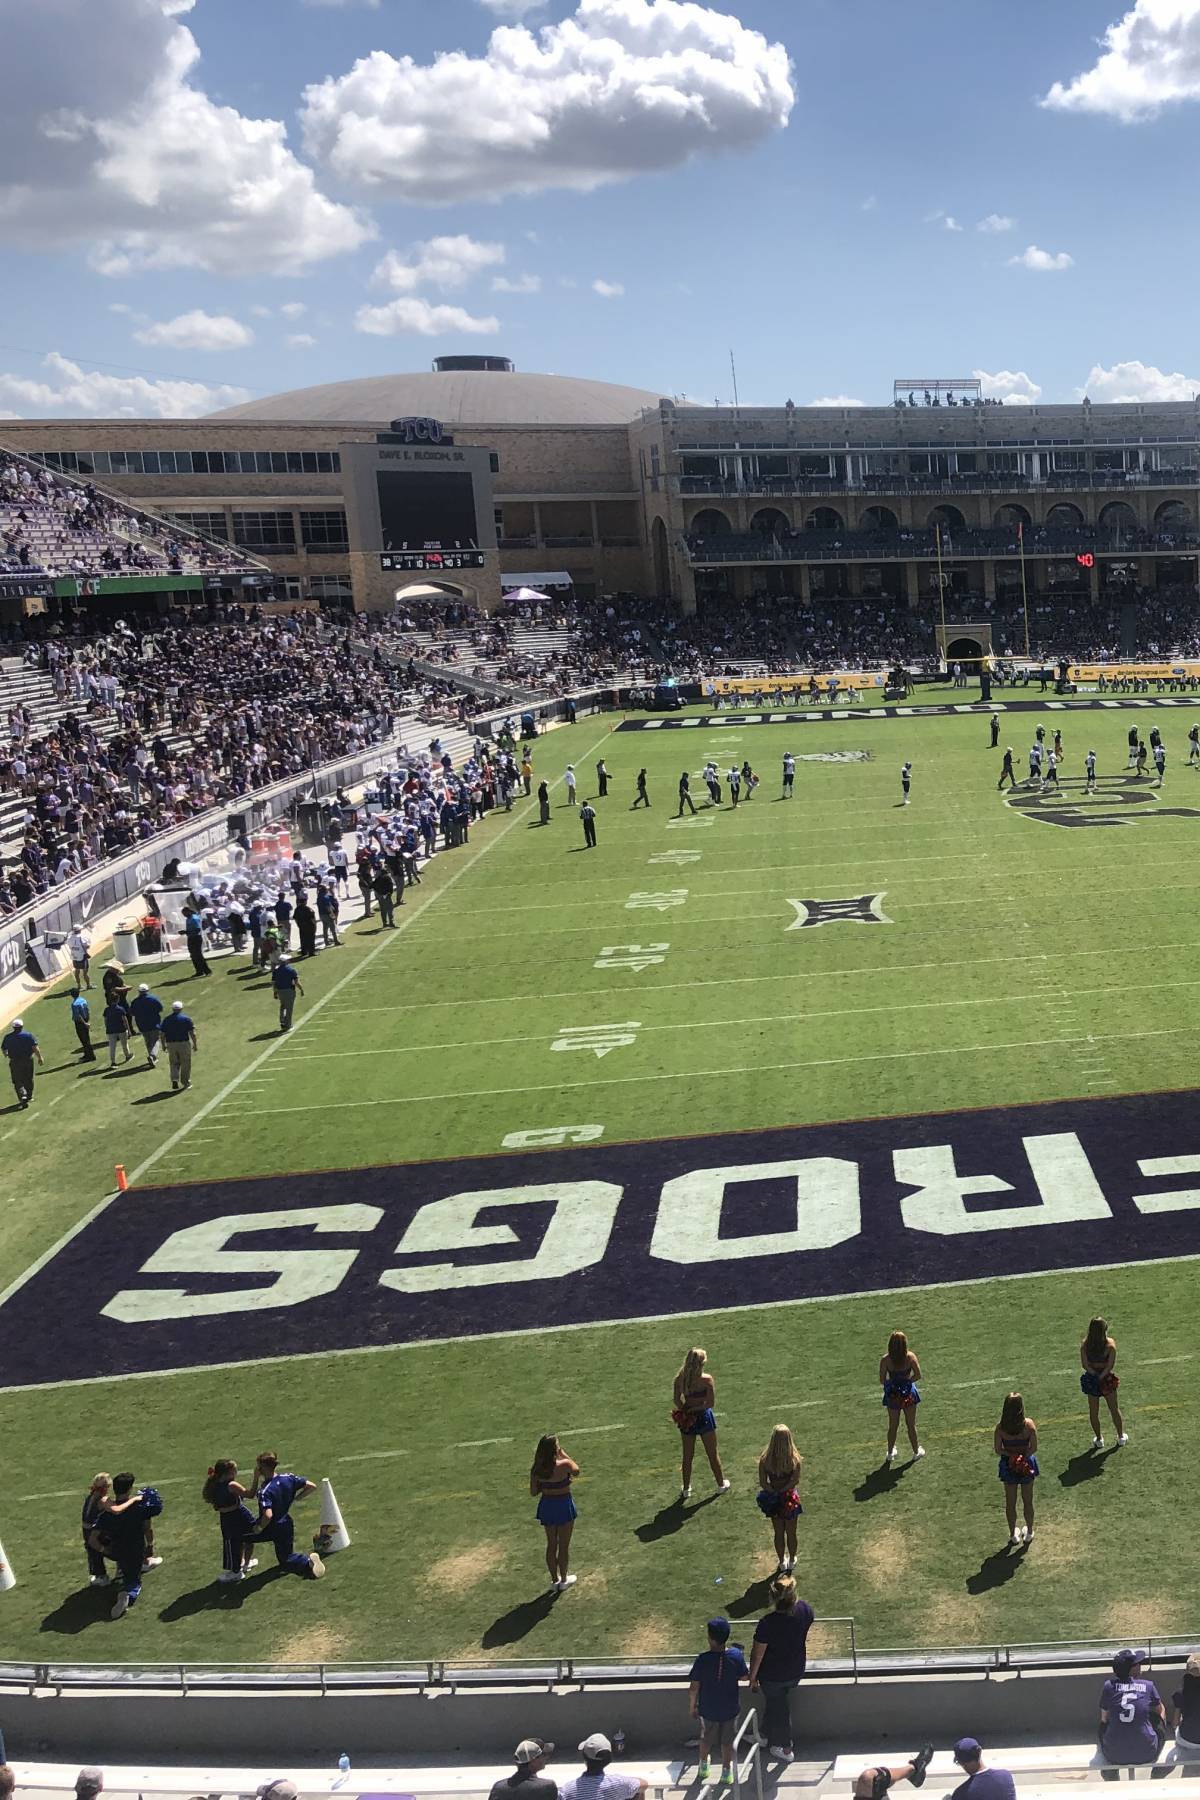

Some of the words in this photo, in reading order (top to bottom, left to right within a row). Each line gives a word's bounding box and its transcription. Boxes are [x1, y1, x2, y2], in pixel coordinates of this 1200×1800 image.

[401, 417, 443, 443] TCU
[382, 558, 391, 567] 38
[1077, 553, 1094, 568] 40
[642, 702, 1008, 728] HORNED
[593, 943, 670, 968] 20
[549, 1022, 642, 1052] 10
[1115, 1683, 1147, 1693] TOMLINSON
[1119, 1693, 1138, 1723] 5
